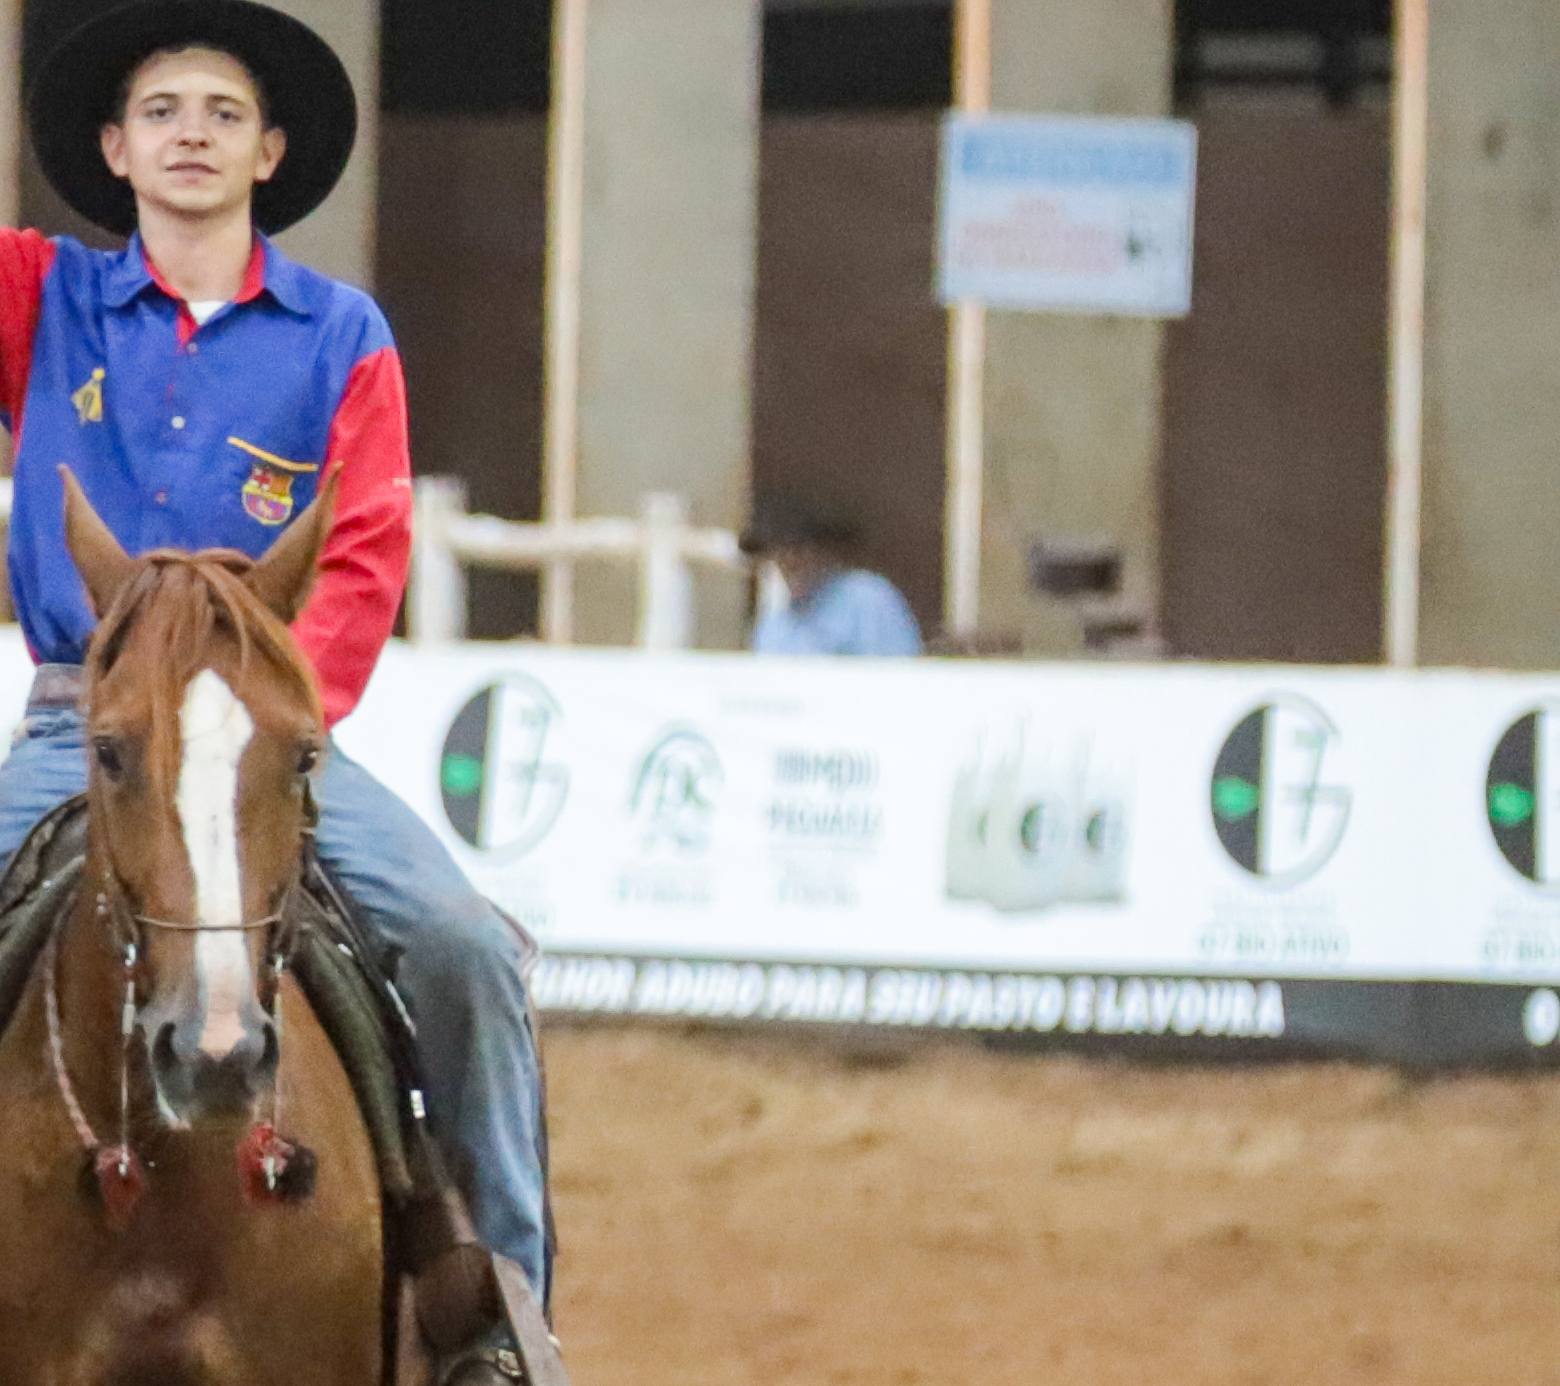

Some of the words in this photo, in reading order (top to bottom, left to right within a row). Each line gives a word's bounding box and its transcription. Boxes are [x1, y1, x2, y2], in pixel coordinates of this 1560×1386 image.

[635, 957, 767, 1019] ADUBO
[765, 963, 868, 1025] PARA
[939, 970, 1066, 1034] PASTO
[1064, 973, 1097, 1035] E
[1095, 973, 1287, 1041] LAVOURA
